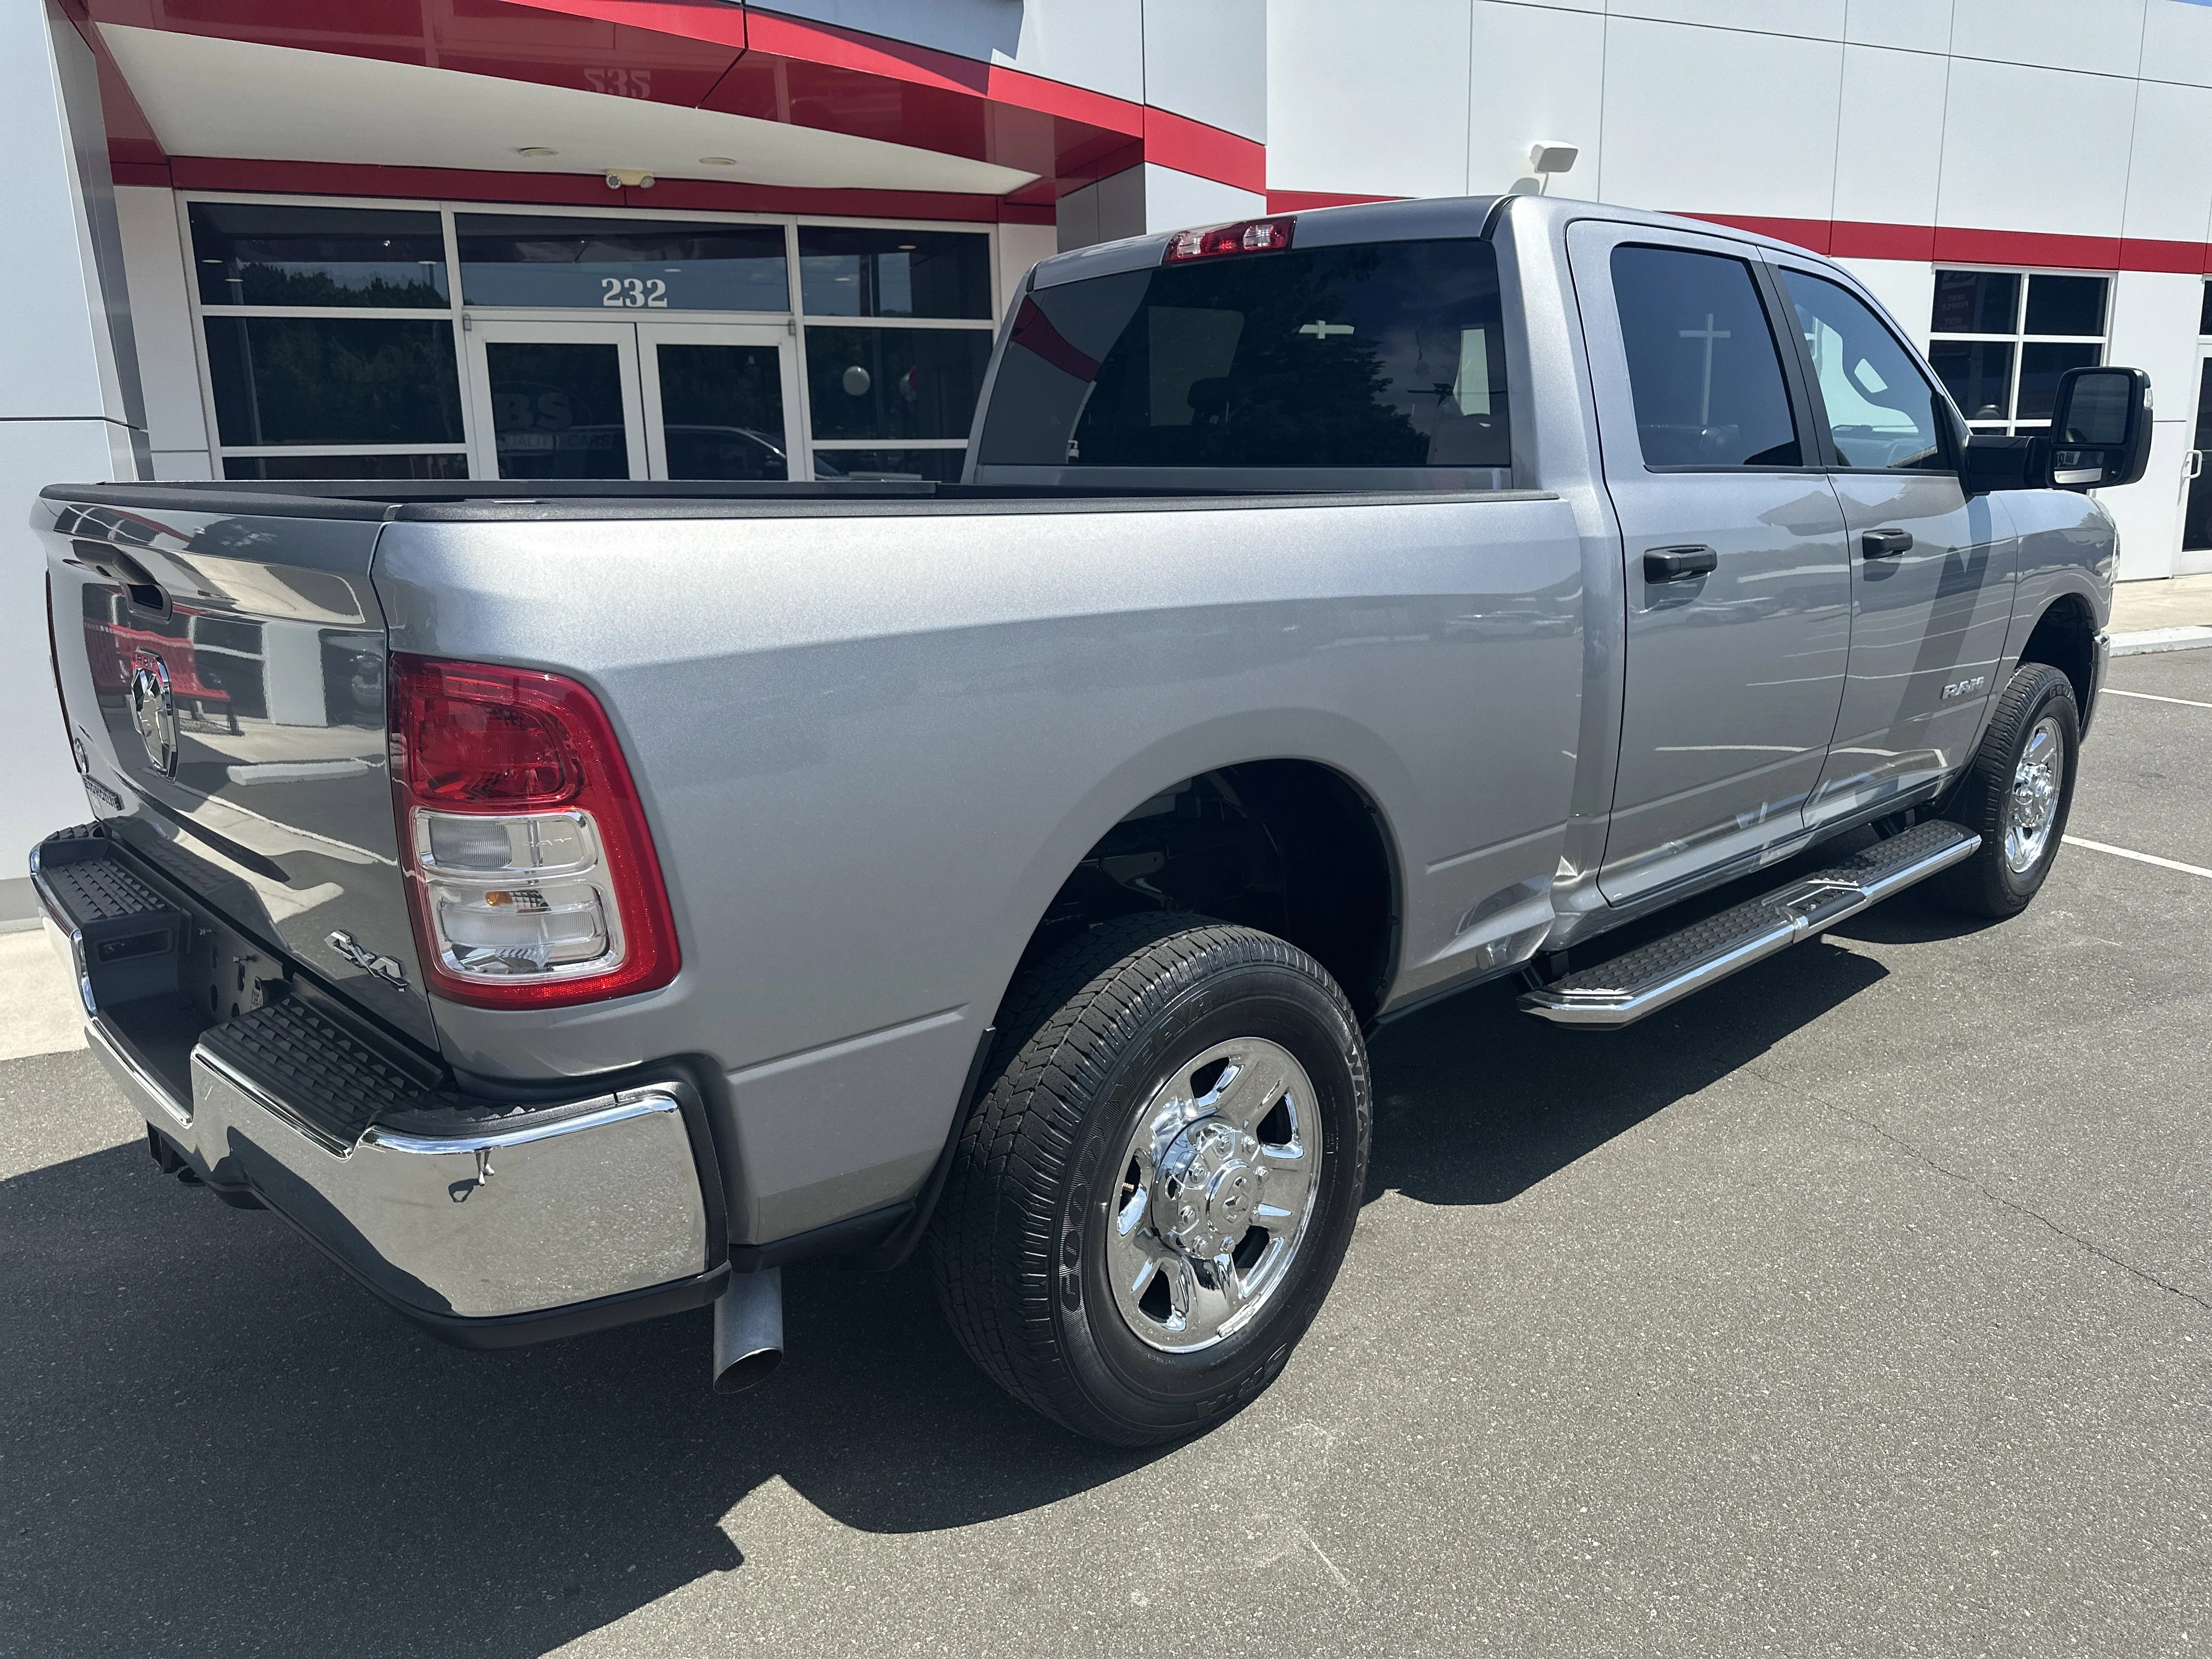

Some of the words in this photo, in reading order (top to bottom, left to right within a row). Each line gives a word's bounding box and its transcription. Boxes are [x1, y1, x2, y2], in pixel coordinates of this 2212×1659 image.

[601, 278, 668, 308] 232
[568, 435, 612, 447] CARS
[1942, 676, 1984, 699] RAM
[1063, 988, 1217, 1311] GOODYEAR
